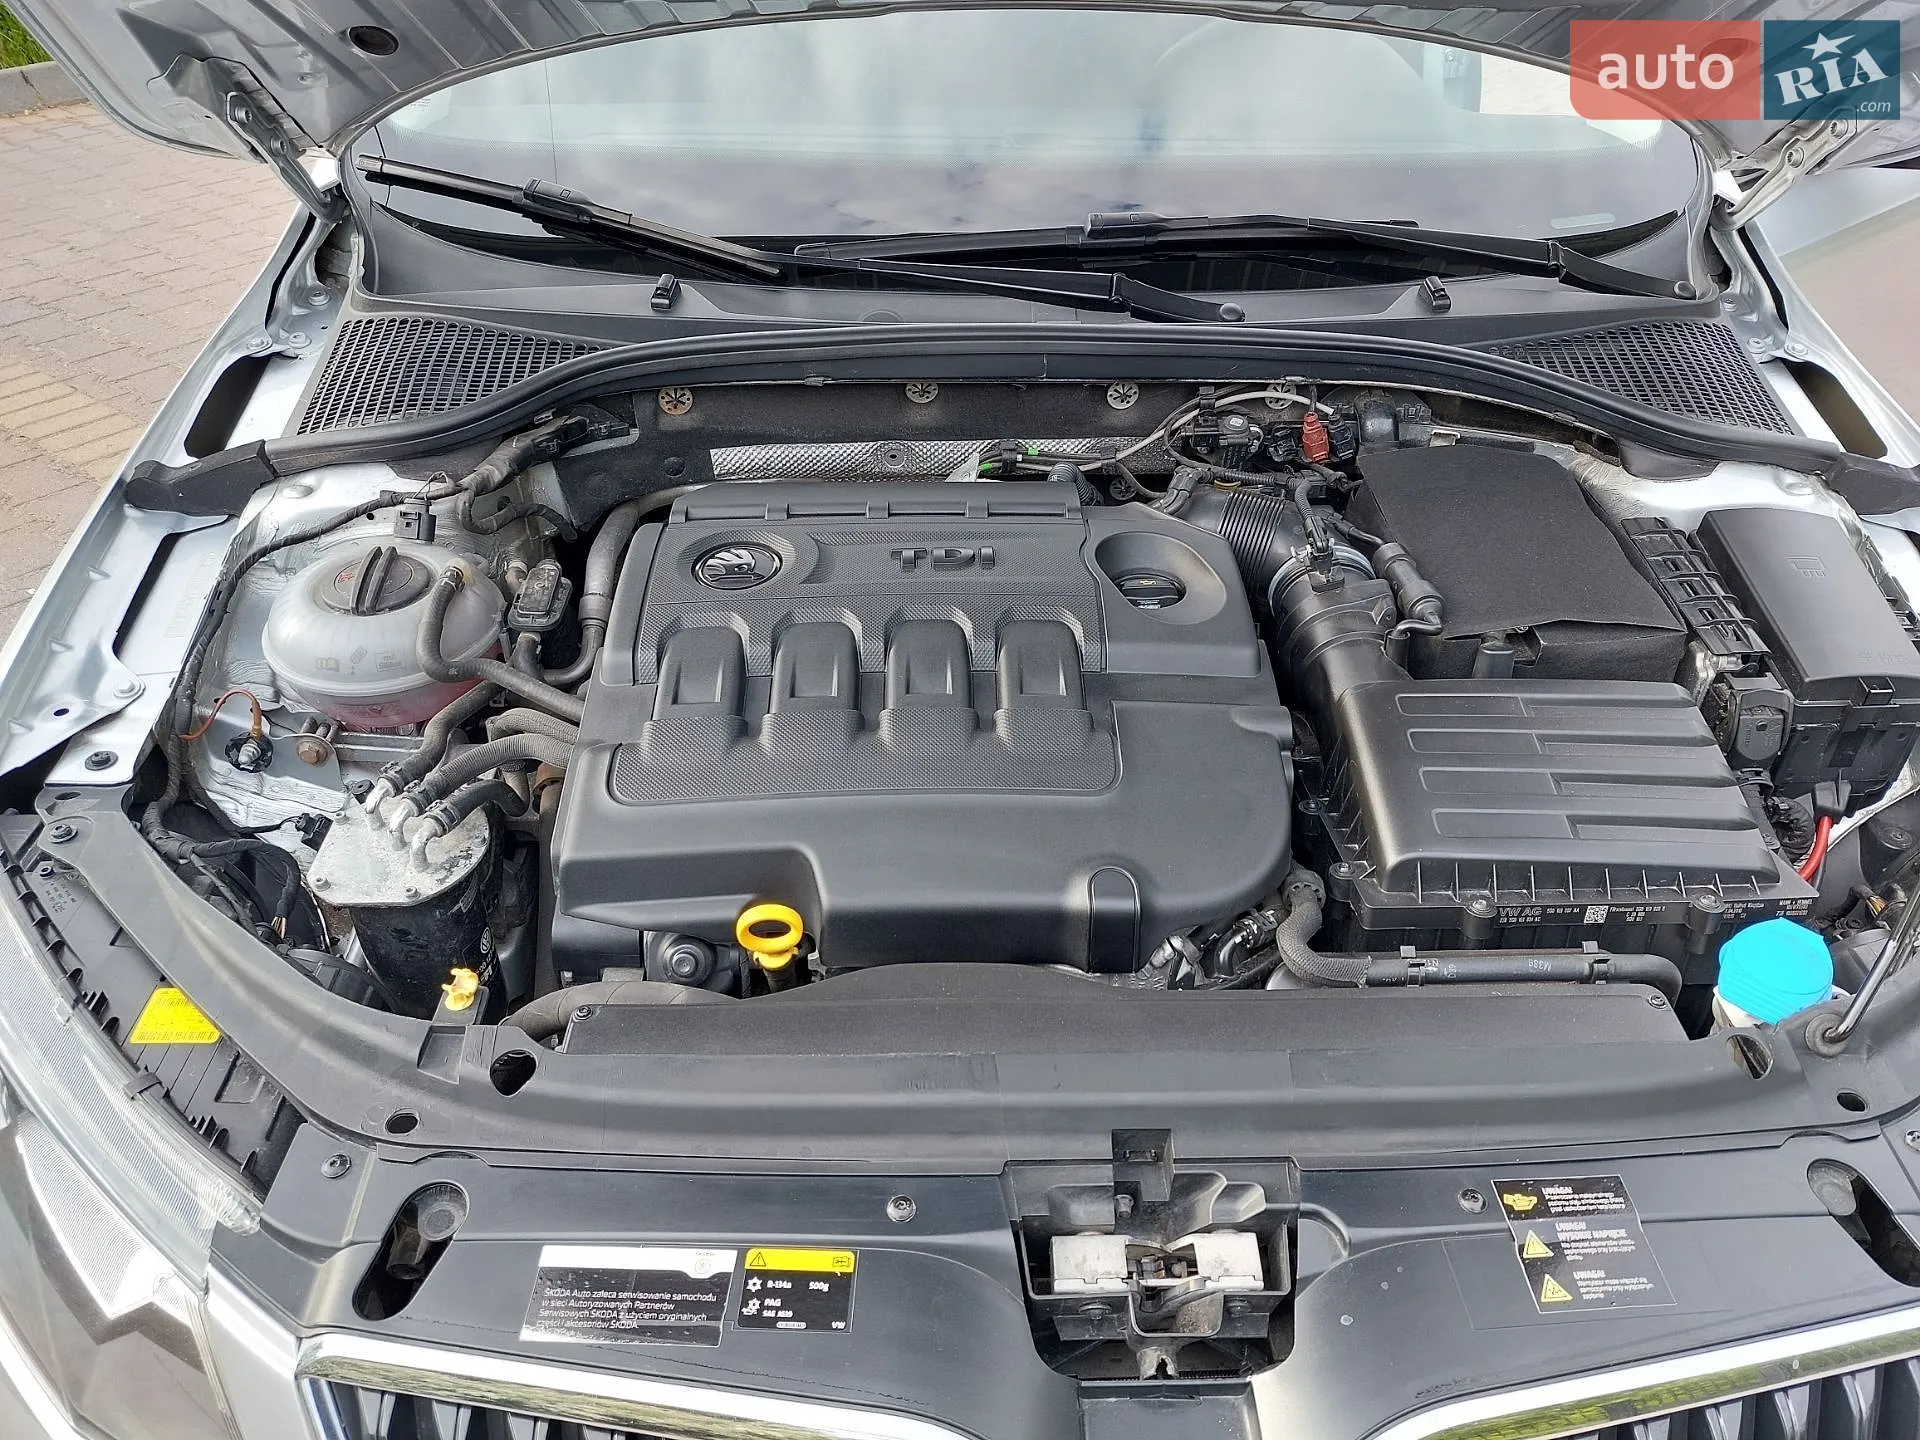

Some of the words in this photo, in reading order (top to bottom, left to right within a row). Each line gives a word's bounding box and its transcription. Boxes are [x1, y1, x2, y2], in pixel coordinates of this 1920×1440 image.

[890, 546, 996, 570] TDI
[1499, 907, 1521, 916] VW
[571, 1289, 591, 1298] Auto
[591, 1290, 617, 1299] zaleca
[618, 1291, 671, 1300] serwisowanie
[672, 1292, 717, 1302] samochodu
[550, 1299, 568, 1307] sieci
[568, 1299, 633, 1310] Autoryzowanych
[634, 1301, 675, 1311] Partnerów
[763, 1298, 782, 1307] PAG
[538, 1309, 590, 1319] Serwisowych
[625, 1311, 658, 1321] użyciem
[658, 1312, 707, 1322] oryginalnych
[564, 1319, 609, 1329] akcesoriów
